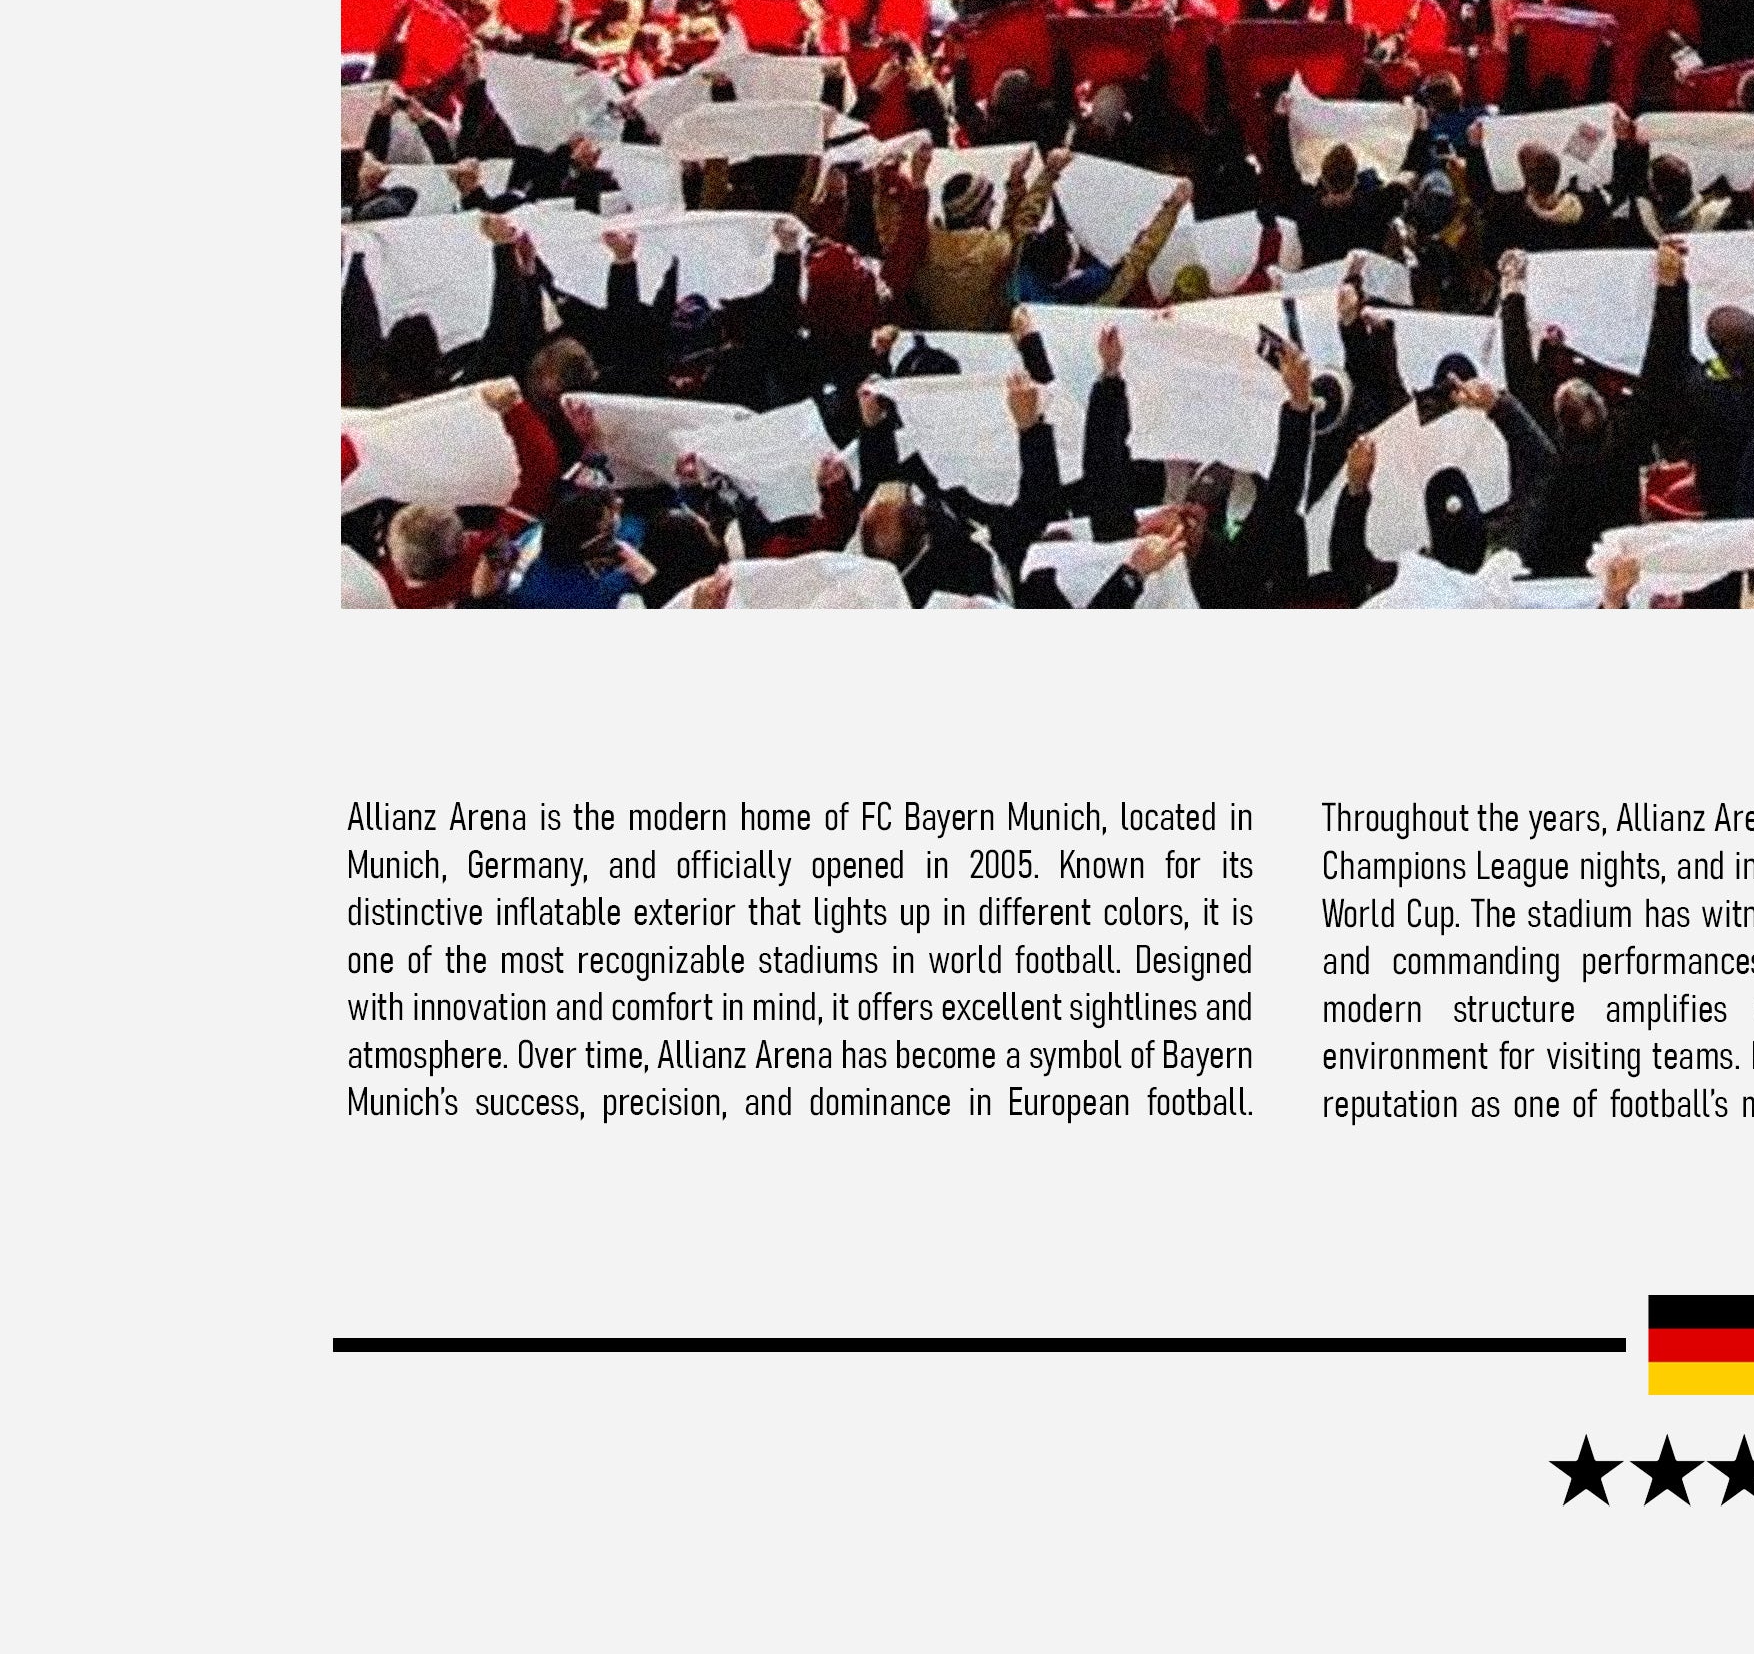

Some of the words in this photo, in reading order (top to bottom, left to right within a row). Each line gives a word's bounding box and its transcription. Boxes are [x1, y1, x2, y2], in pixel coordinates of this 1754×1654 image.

[347, 801, 437, 831] Allianz
[449, 801, 526, 831] Arena
[540, 802, 561, 831] is
[573, 801, 615, 831] the
[629, 801, 726, 831] modern
[741, 801, 811, 831] home
[825, 801, 850, 831] of
[862, 801, 892, 831] FC
[905, 801, 994, 839] Bayern
[1008, 801, 1107, 836] Munich,
[1121, 801, 1216, 831] located
[1231, 802, 1252, 831] in
[1321, 802, 1469, 840] Throughout
[1477, 802, 1519, 832] the
[1528, 810, 1607, 840] years,
[1616, 802, 1706, 832] Allianz
[348, 849, 447, 884] Munich,
[468, 849, 588, 887] Germany,
[609, 849, 656, 879] and
[677, 849, 792, 887] officially
[812, 849, 904, 887] opened
[927, 850, 948, 879] in
[970, 849, 1039, 879] 2005.
[1060, 849, 1144, 879] Known
[1165, 849, 1201, 879] for
[1223, 850, 1253, 879] its
[1323, 850, 1466, 888] Champions
[1477, 850, 1569, 888] League
[1580, 850, 1666, 888] nights,
[1677, 850, 1724, 880] and
[1321, 898, 1395, 928] World
[1407, 898, 1460, 936] Cup.
[1470, 898, 1516, 928] The
[1527, 898, 1632, 928] stadium
[1645, 898, 1690, 928] has
[348, 952, 394, 974] one
[408, 944, 433, 974] of
[445, 944, 487, 974] the
[501, 946, 564, 974] most
[578, 944, 745, 982] recognizable
[758, 944, 878, 974] stadiums
[893, 945, 914, 974] in
[928, 944, 1002, 974] world
[1015, 944, 1121, 974] football.
[1136, 944, 1252, 982] Designed
[347, 991, 403, 1021] with
[413, 992, 546, 1021] innovation
[556, 991, 603, 1021] and
[612, 991, 713, 1021] comfort
[723, 992, 743, 1021] in
[753, 991, 823, 1026] mind,
[832, 992, 849, 1021] it
[858, 991, 933, 1021] offers
[942, 991, 1062, 1021] excellent
[1069, 991, 1197, 1029] sightlines
[1206, 991, 1252, 1021] and
[1323, 993, 1421, 1023] modern
[1453, 995, 1575, 1023] structure
[1606, 993, 1727, 1031] amplifies
[1323, 1041, 1488, 1070] environment
[1499, 1040, 1535, 1070] for
[1546, 1041, 1641, 1078] visiting
[1652, 1042, 1740, 1070] teams.
